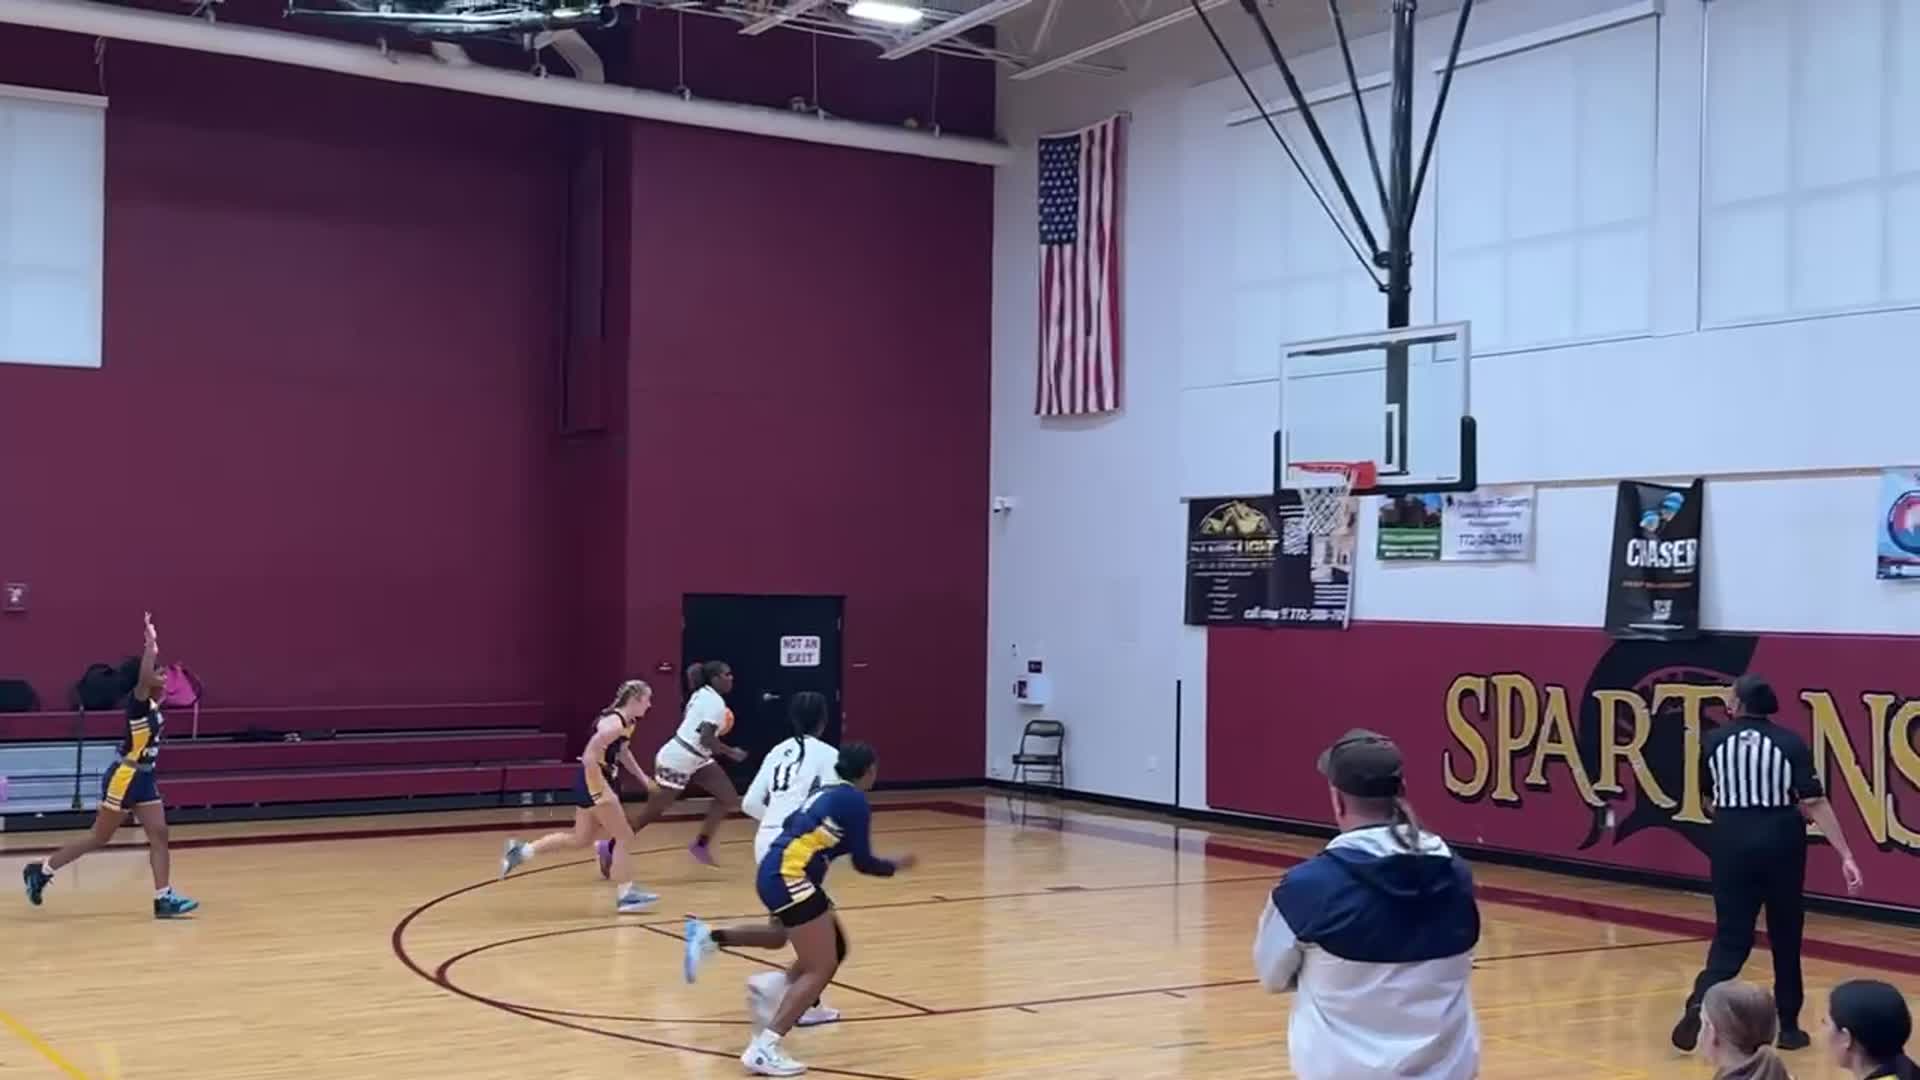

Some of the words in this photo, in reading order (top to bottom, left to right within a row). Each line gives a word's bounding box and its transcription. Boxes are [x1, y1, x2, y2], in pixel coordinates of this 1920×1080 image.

[783, 639, 802, 649] NOT
[805, 639, 818, 649] AN
[787, 652, 815, 664] EXIT
